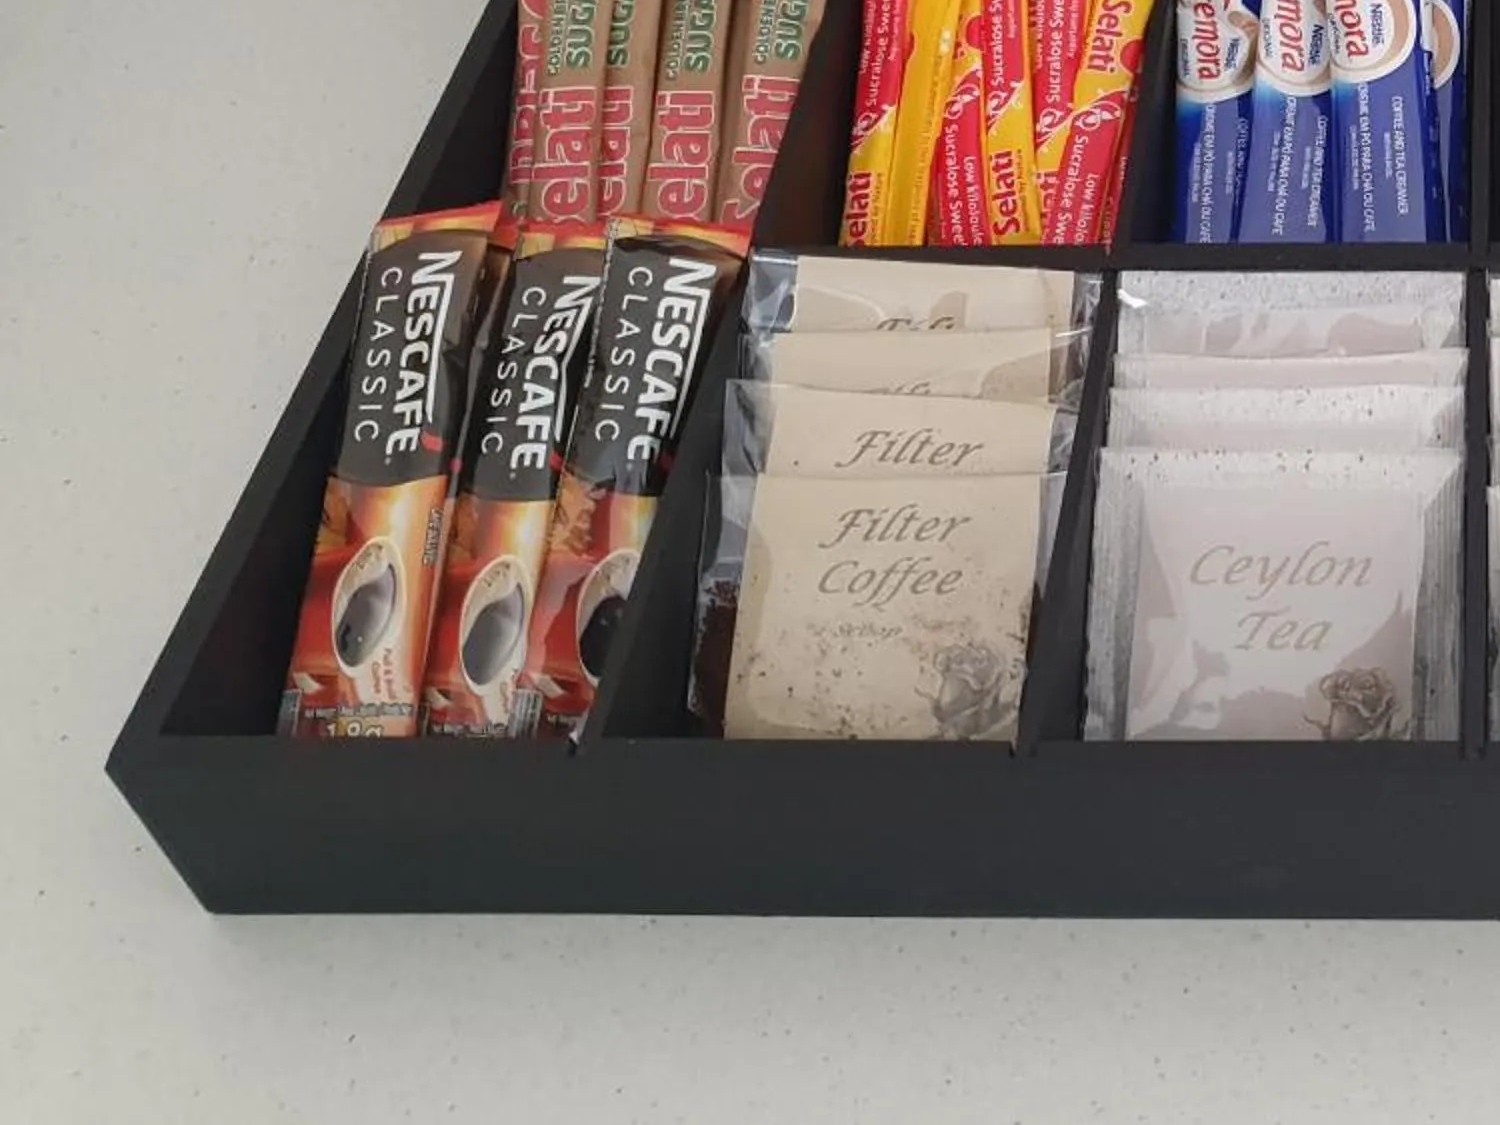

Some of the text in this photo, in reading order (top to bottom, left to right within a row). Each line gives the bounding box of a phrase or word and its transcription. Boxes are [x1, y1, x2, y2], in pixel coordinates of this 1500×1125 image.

[989, 17, 1005, 87] Sucralose
[1046, 30, 1064, 104] Sucralose
[532, 86, 598, 225] elati
[648, 90, 715, 223] elati
[944, 124, 968, 246] Sucralose Swee
[963, 156, 977, 182] Low
[1062, 135, 1089, 208] Sucralose
[1084, 173, 1100, 202] Low
[846, 171, 873, 246] elati
[990, 150, 1020, 236] Selati
[354, 266, 403, 443] CLASSIC
[481, 286, 547, 454] CLASSIC
[595, 266, 653, 442] CLASSIC
[834, 427, 985, 469] Filter
[817, 502, 975, 550] Filter
[817, 556, 964, 613] Coffee
[1189, 540, 1374, 601] Ceylon
[1234, 609, 1334, 653] Tea
